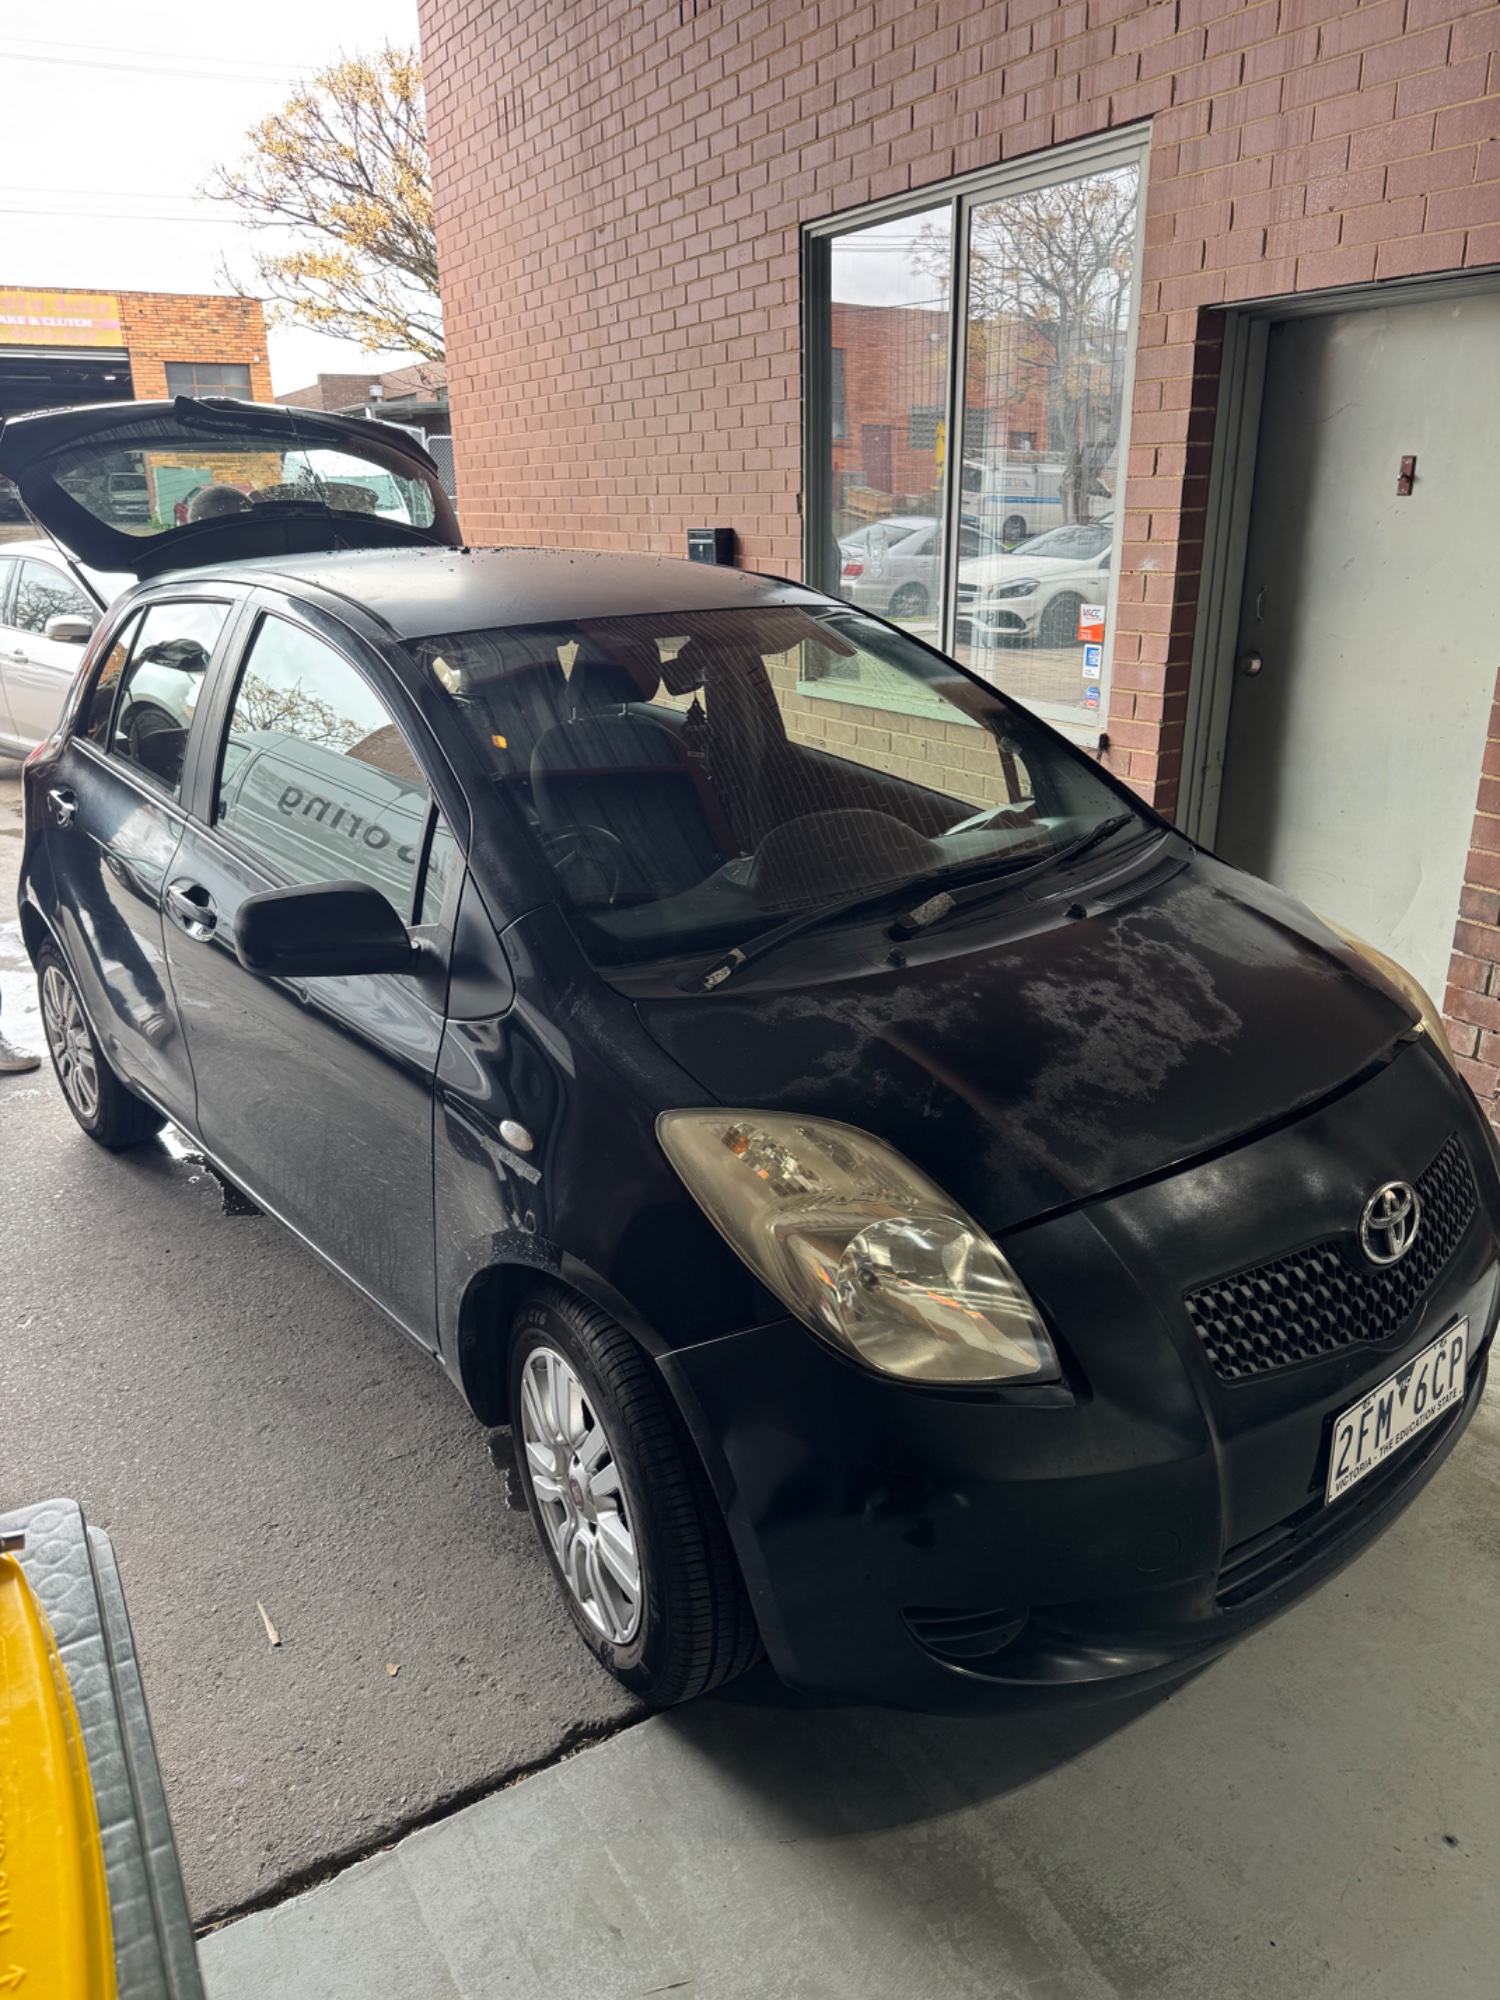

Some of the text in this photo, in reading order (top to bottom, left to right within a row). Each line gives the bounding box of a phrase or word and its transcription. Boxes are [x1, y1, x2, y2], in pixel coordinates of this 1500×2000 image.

[42, 318, 92, 327] CLUTCH
[1335, 1461, 1372, 1492] VICTORIA
[1379, 1442, 1394, 1457] THE
[1394, 1407, 1436, 1445] EDUCATION
[1436, 1389, 1458, 1412] STATE
[1336, 1335, 1464, 1481] 2FM 6CP
